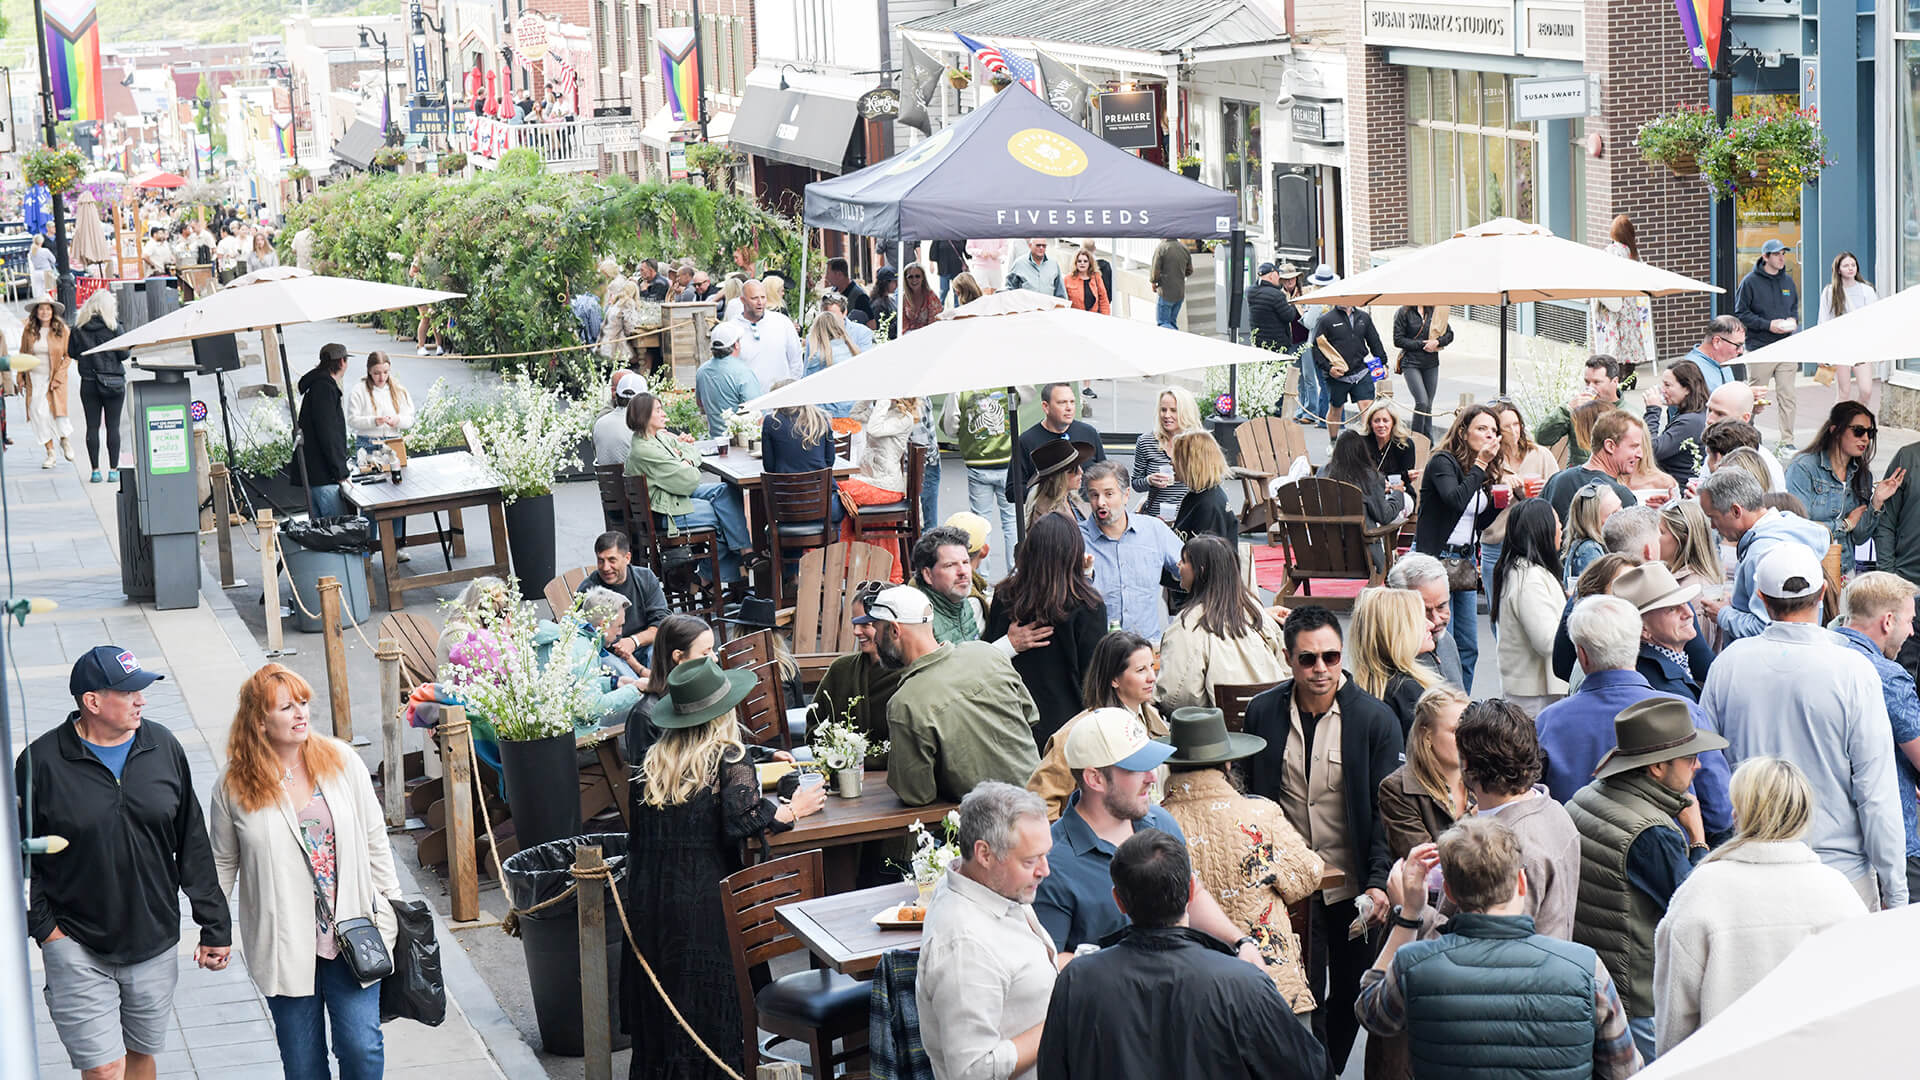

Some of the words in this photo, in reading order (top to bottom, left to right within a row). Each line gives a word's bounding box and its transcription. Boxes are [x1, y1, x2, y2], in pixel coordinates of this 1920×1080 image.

[1372, 11, 1405, 29] SUSAN
[1408, 13, 1453, 33] SWARTZ
[1455, 15, 1504, 36] STUDIOS
[1551, 90, 1582, 99] SWARTZ
[1104, 112, 1152, 123] PREMIERE
[1292, 107, 1320, 125] PREMIERE
